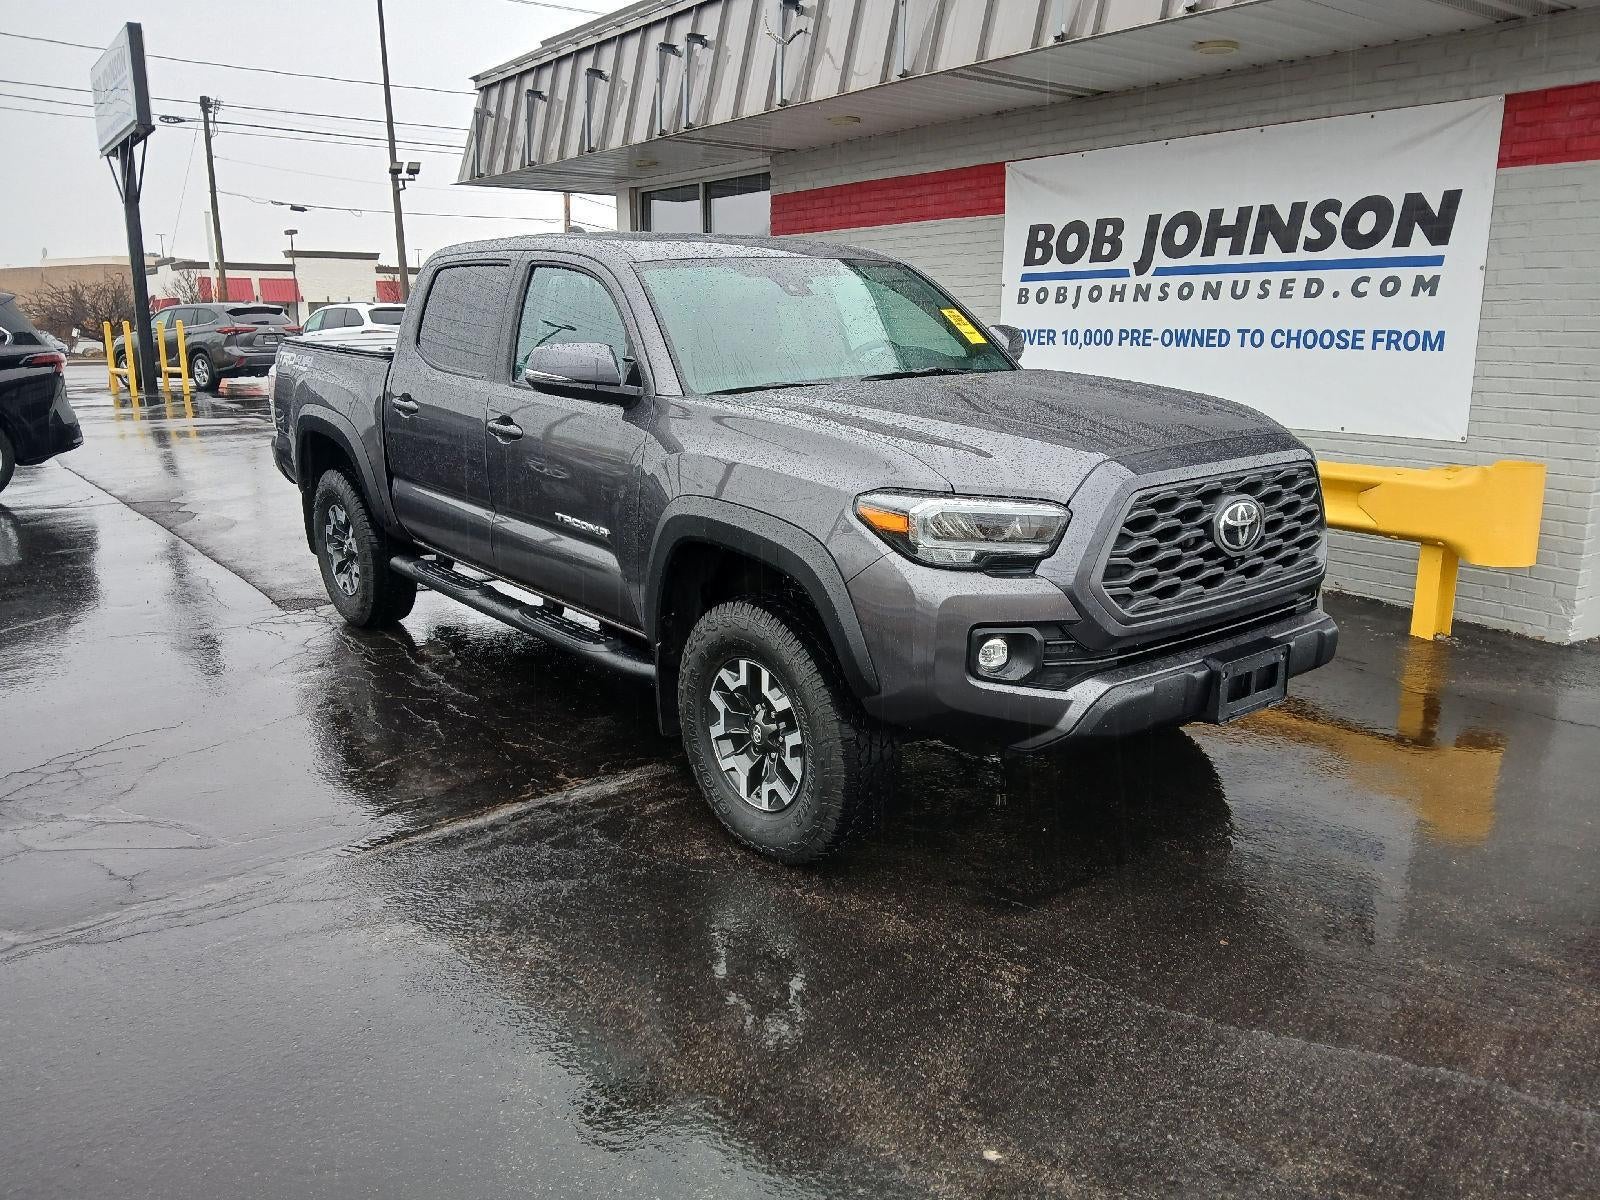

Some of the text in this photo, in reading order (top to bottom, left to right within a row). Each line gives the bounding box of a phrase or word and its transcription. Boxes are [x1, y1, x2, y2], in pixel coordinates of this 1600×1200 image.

[1023, 188, 1463, 277] BOB JOHNSON
[1017, 274, 1441, 309] BOBJOHNSONUSED.COM
[1061, 328, 1114, 350] 10,000
[1118, 328, 1231, 348] PRE-OWNED
[1237, 328, 1265, 350] TO
[1270, 328, 1366, 351] CHOOSE
[1371, 329, 1446, 352] FROM
[554, 512, 611, 538] TACOMA
